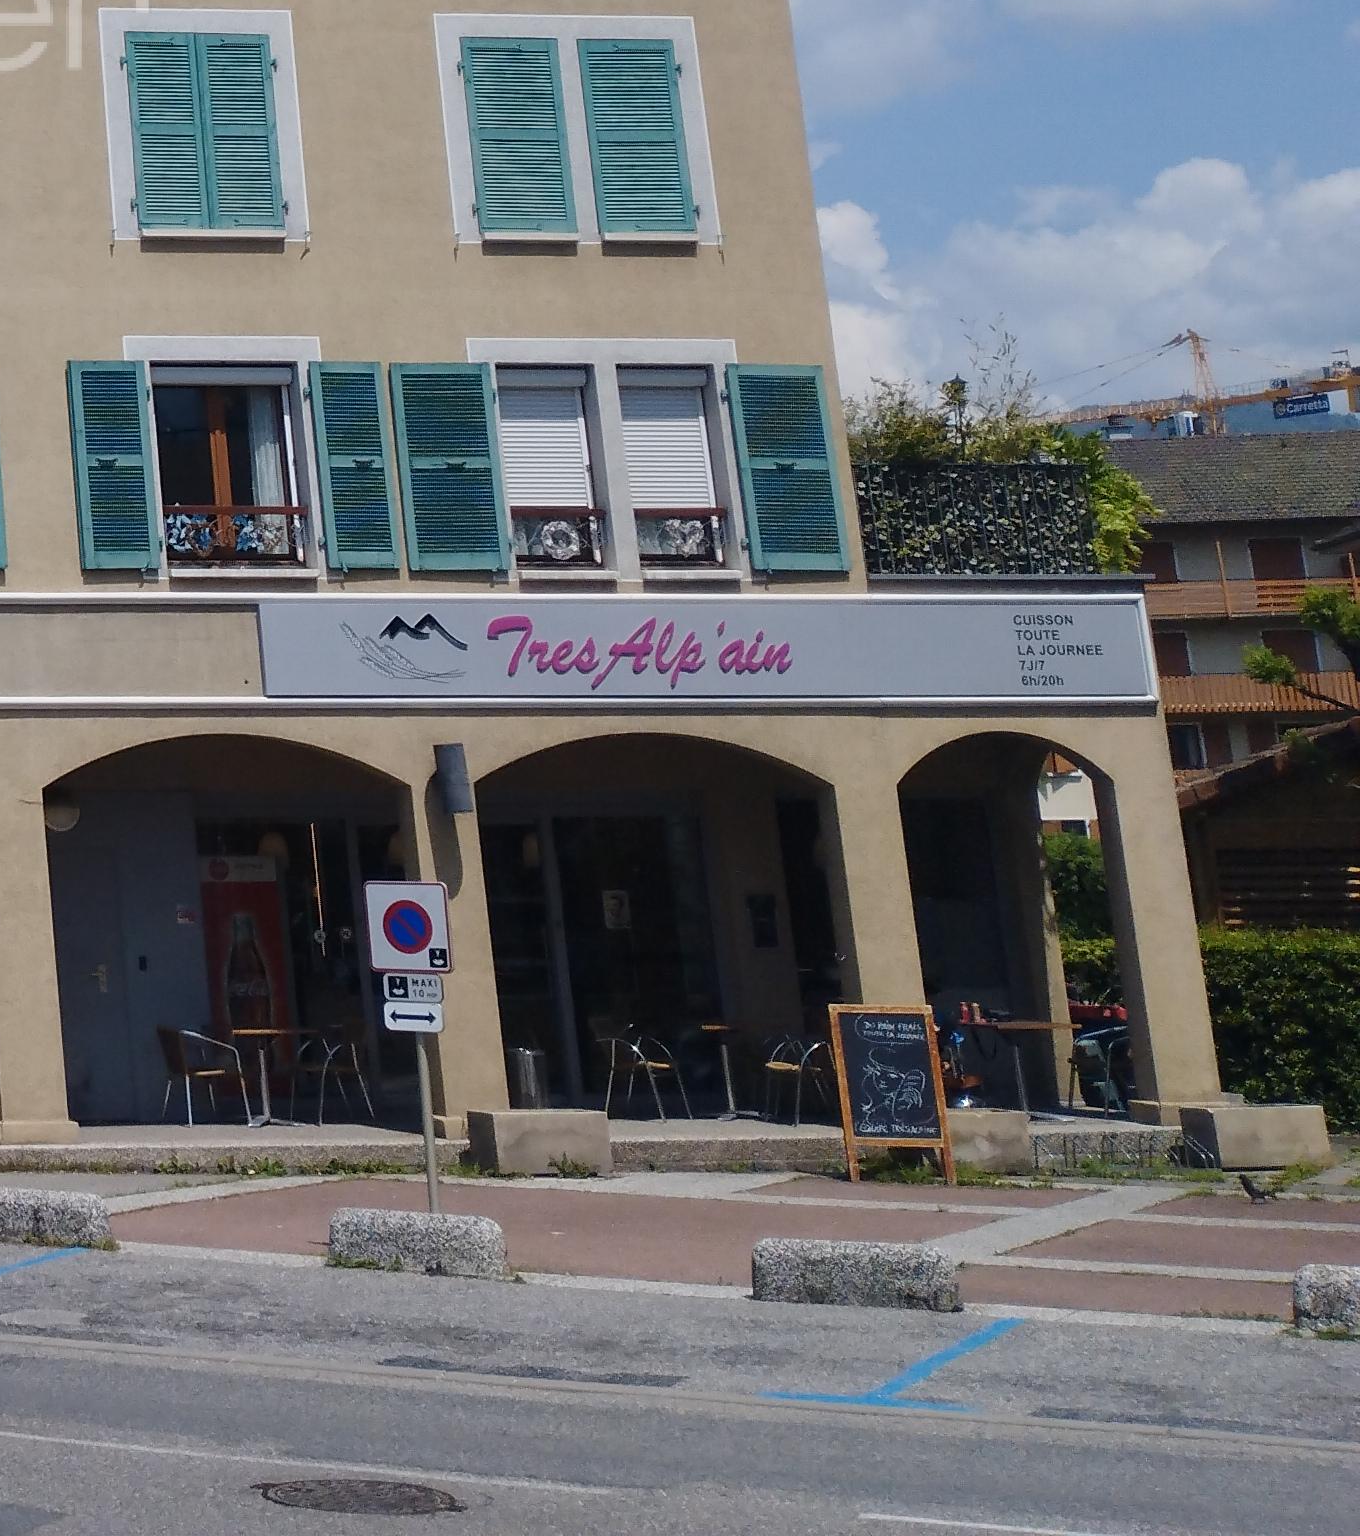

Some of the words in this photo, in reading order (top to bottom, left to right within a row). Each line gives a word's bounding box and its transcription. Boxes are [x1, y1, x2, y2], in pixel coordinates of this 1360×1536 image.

[1013, 614, 1074, 625] CUISSON
[1015, 629, 1061, 640] TOUTE
[487, 615, 599, 677] Tres
[591, 617, 793, 690] Alp'ain
[1017, 645, 1035, 655] LA
[1040, 645, 1104, 656] JOURNEE
[1019, 660, 1045, 671] 7J/7
[1021, 675, 1064, 686] 6h/20h
[411, 978, 438, 988] MAXI
